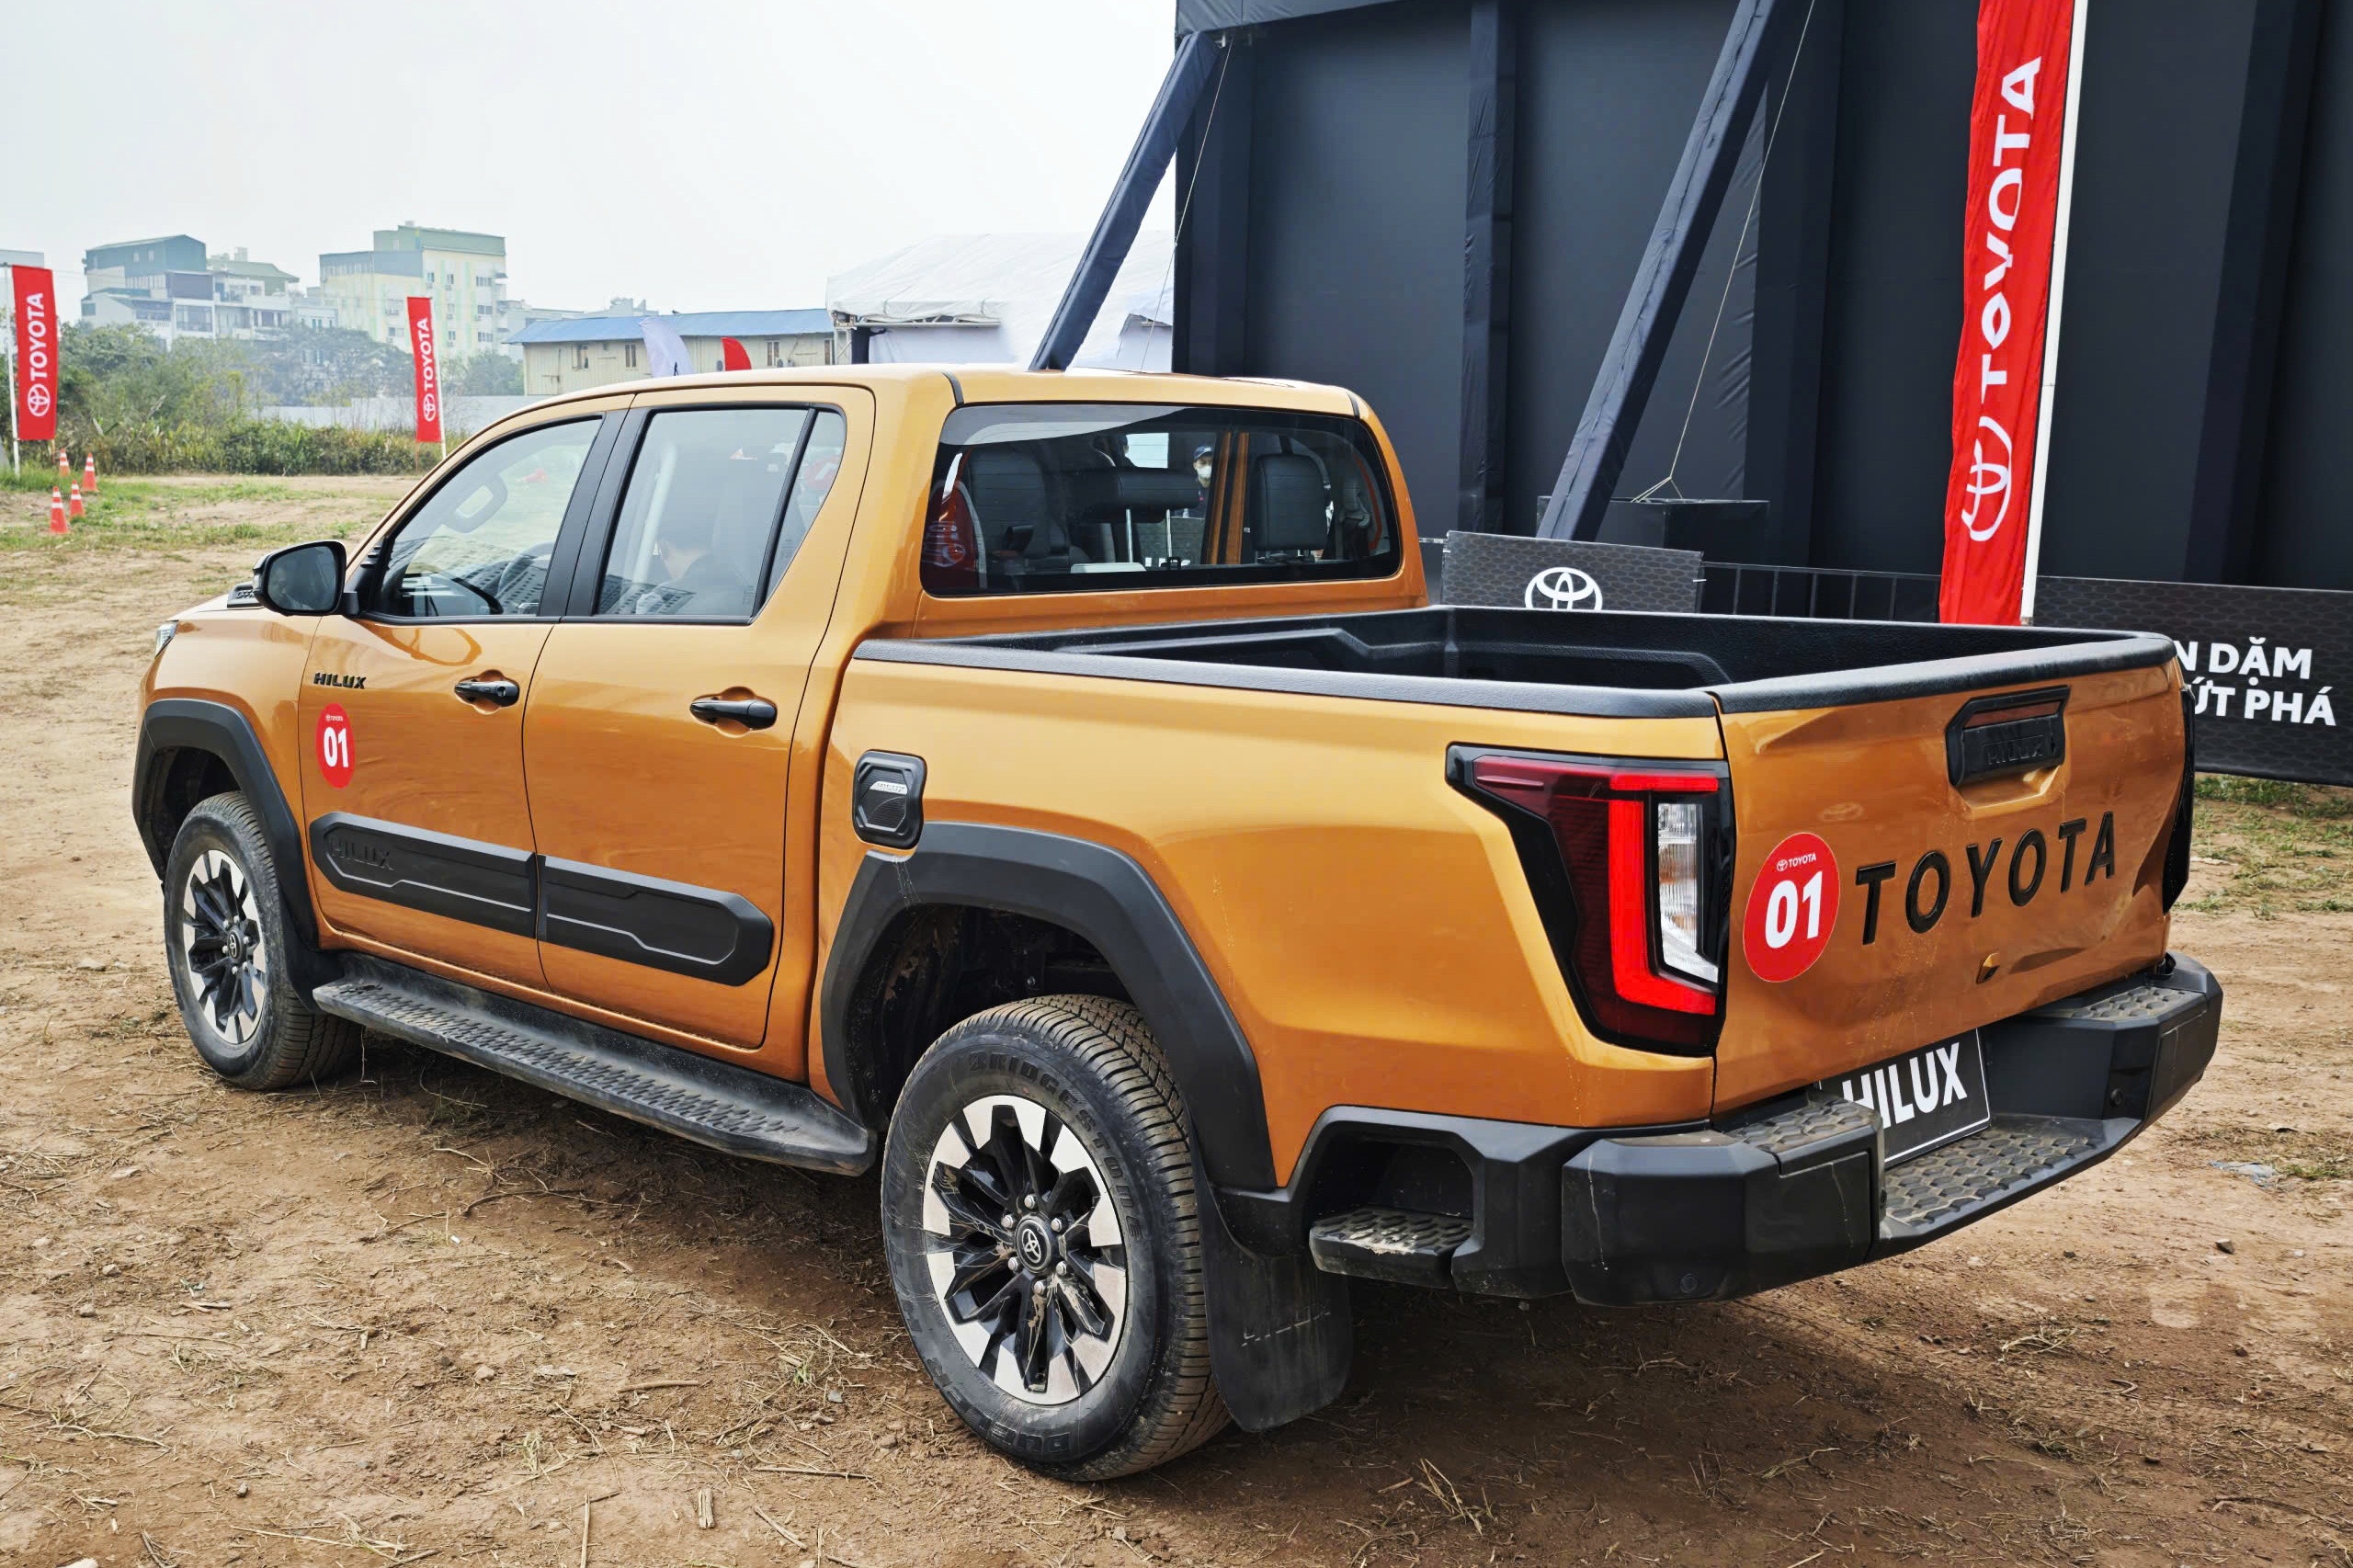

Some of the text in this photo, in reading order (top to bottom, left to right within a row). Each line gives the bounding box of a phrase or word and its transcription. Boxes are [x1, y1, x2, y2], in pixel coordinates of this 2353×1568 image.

[26, 292, 48, 381] TOYOTA
[416, 317, 434, 392] TOYOTA
[313, 672, 367, 689] HILUX
[2208, 636, 2313, 686] DẶM
[2244, 686, 2336, 726] PHÁ
[324, 726, 349, 767] 01
[1788, 852, 1817, 869] TOYOTA
[1856, 811, 2115, 946] TOYOTA
[1765, 870, 1823, 949] 01
[1841, 1041, 1968, 1130] HILUX
